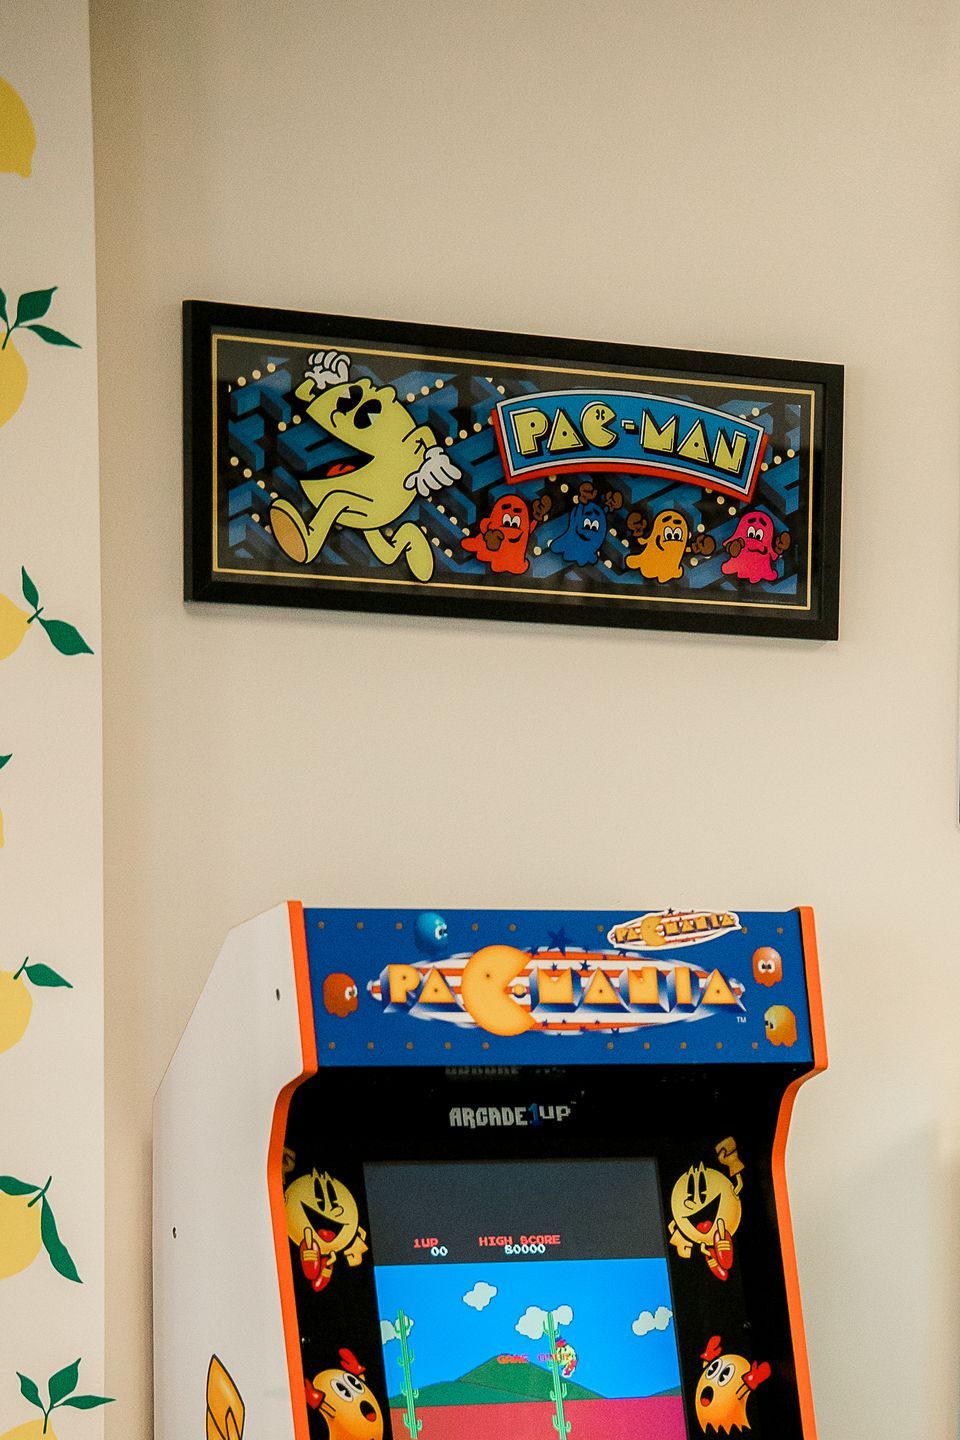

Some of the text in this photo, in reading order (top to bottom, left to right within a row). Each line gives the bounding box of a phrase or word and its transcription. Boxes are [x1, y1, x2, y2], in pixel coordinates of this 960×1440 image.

[508, 400, 748, 474] PAC-MAN
[413, 1235, 561, 1248] 1UP HIGH SCORE
[431, 1244, 546, 1256] 00 80000
